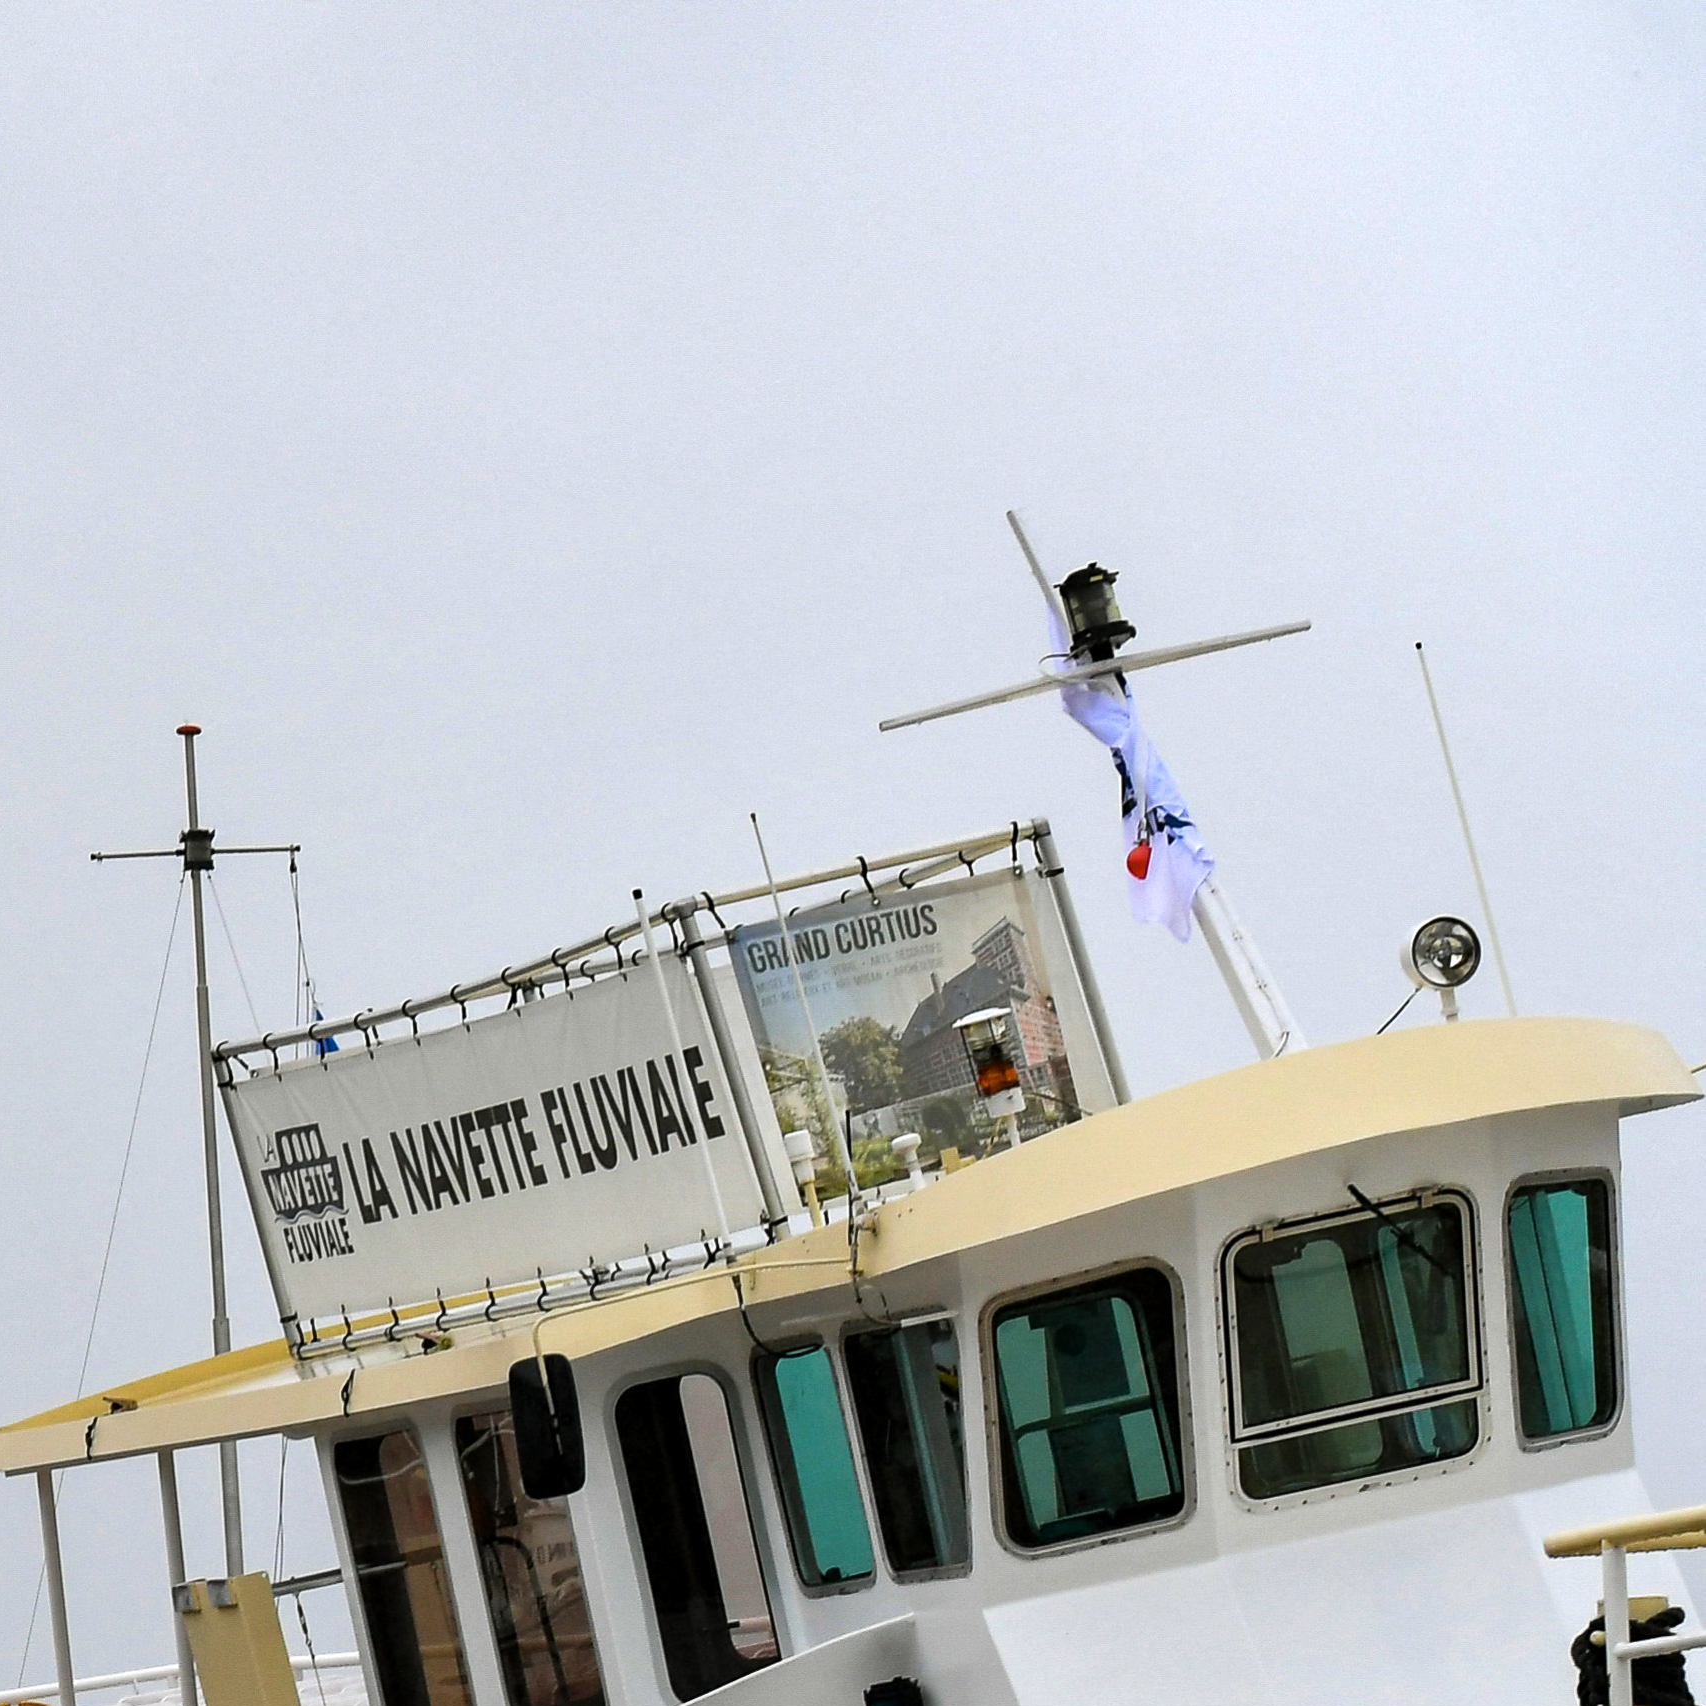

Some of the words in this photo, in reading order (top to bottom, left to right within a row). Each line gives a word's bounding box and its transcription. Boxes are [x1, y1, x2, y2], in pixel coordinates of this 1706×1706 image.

[747, 927, 831, 973] GRAND
[834, 904, 937, 955] CURTIUS
[268, 1163, 340, 1212] NAVETTE
[343, 1136, 399, 1224] LA
[389, 1098, 549, 1216] NAVETTE
[283, 1217, 356, 1264] FLUVIALE
